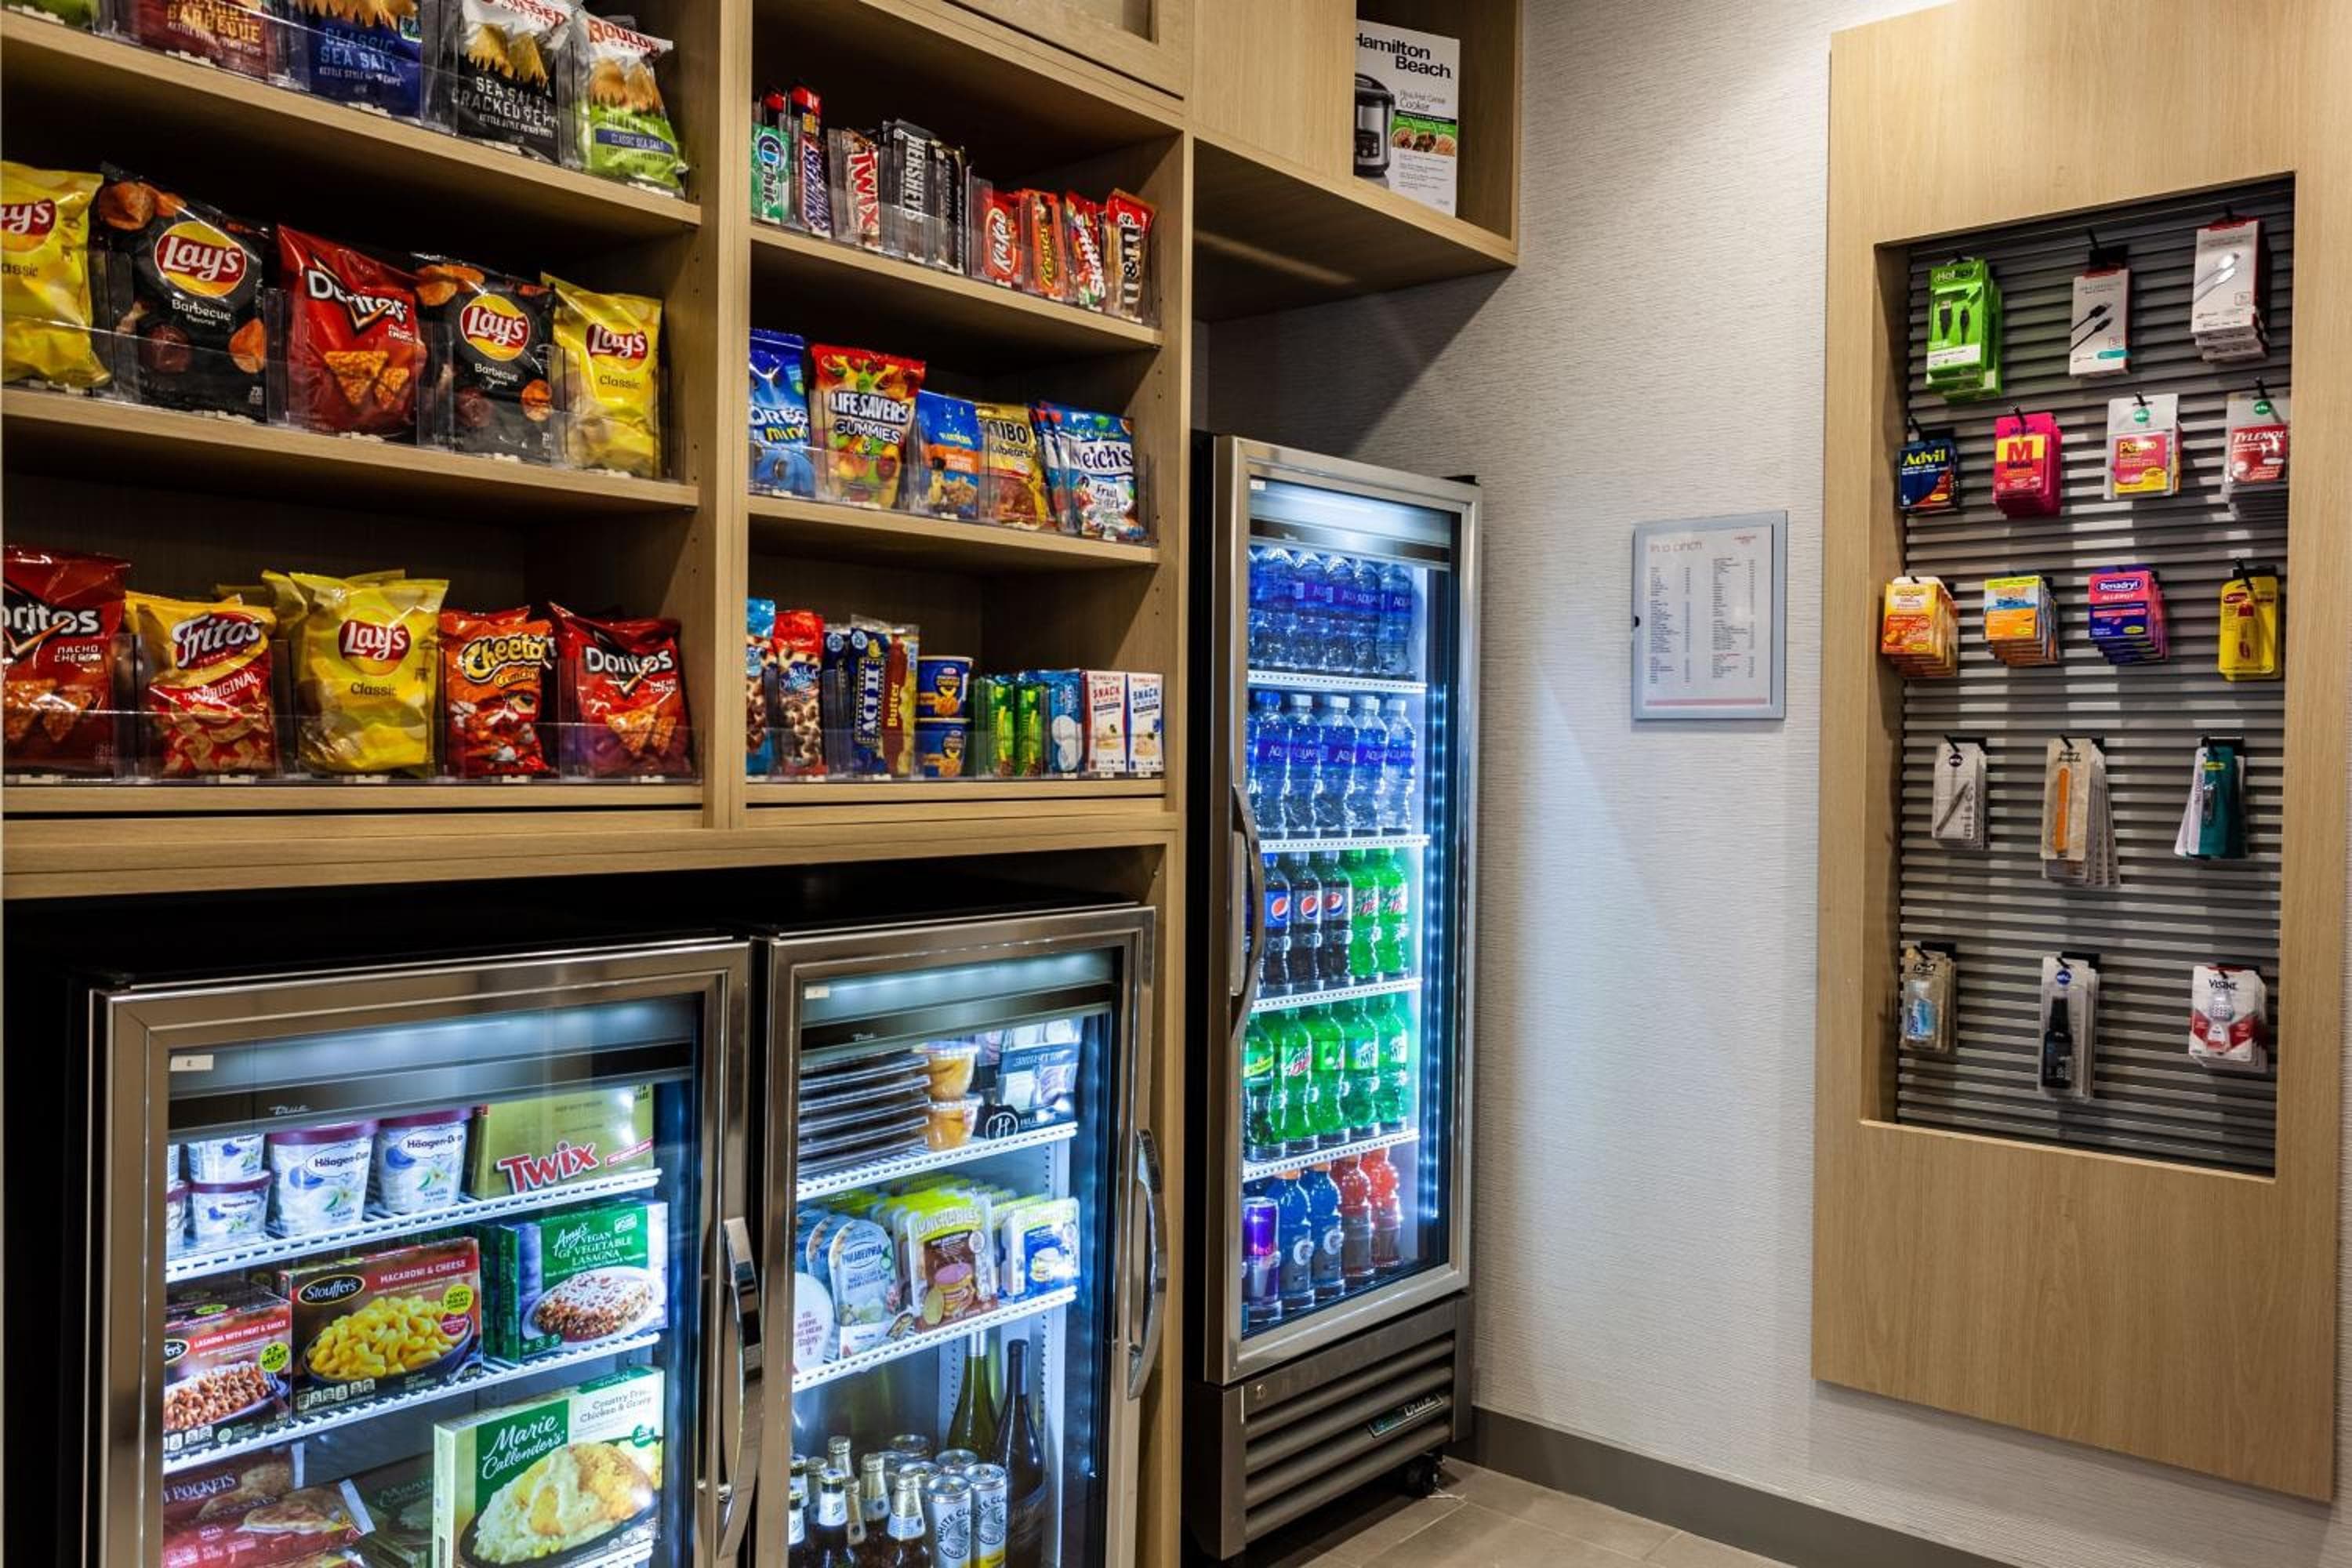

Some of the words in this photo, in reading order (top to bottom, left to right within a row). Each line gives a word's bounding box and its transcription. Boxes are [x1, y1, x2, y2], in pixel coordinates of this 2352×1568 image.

[167, 3, 260, 44] BARBEQUE
[325, 27, 395, 53] CLASSIC
[321, 46, 353, 66] SEA
[359, 52, 397, 72] SALT
[1395, 56, 1450, 78] Beach
[476, 77, 504, 99] SEA
[452, 87, 521, 120] CRACKED
[852, 149, 878, 229] TWIX
[2, 201, 53, 238] ay's
[2, 262, 39, 276] assic
[162, 236, 242, 281] Lay's
[307, 270, 408, 322] Doritos
[171, 298, 232, 321] Barbecue
[468, 305, 524, 344] Lay's
[590, 324, 646, 360] Lay's
[474, 362, 519, 383] Barbecue
[599, 374, 640, 390] Classic
[830, 392, 858, 413] LIFE
[858, 394, 909, 423] SAVERS
[835, 418, 901, 444] GUMMIES
[2234, 430, 2284, 444] TYLENOL
[1904, 448, 1946, 466] Advil
[2007, 440, 2033, 462] M
[2100, 579, 2139, 591] Benadryl
[2, 601, 100, 634] ritos
[57, 644, 99, 655] NACHO
[172, 614, 260, 668] Fritos
[344, 621, 408, 662] Lay's
[463, 633, 549, 679] Cheeto
[585, 645, 674, 673] Doritos
[201, 671, 260, 700] ORIGINAL
[350, 681, 397, 698] Classic
[1093, 685, 1120, 699] SNACK
[1133, 688, 1158, 701] SNACK
[887, 682, 901, 728] Butter
[269, 1104, 313, 1116] True
[498, 1142, 599, 1193] Twix
[552, 1222, 590, 1258] Amy's
[574, 1236, 633, 1255] VEGETABLE
[580, 1231, 612, 1243] VEGAN
[572, 1249, 620, 1267] LASAGNA
[379, 1269, 426, 1284] MACARONI
[435, 1259, 466, 1272] CHEESE
[306, 1279, 358, 1301] Stouffer's
[194, 1335, 225, 1348] LASAGNA
[579, 1407, 617, 1423] Chicken
[592, 1396, 628, 1410] Country
[482, 1415, 558, 1461] Marie
[482, 1430, 565, 1480] Callender's
[170, 1472, 236, 1500] POCKETS
